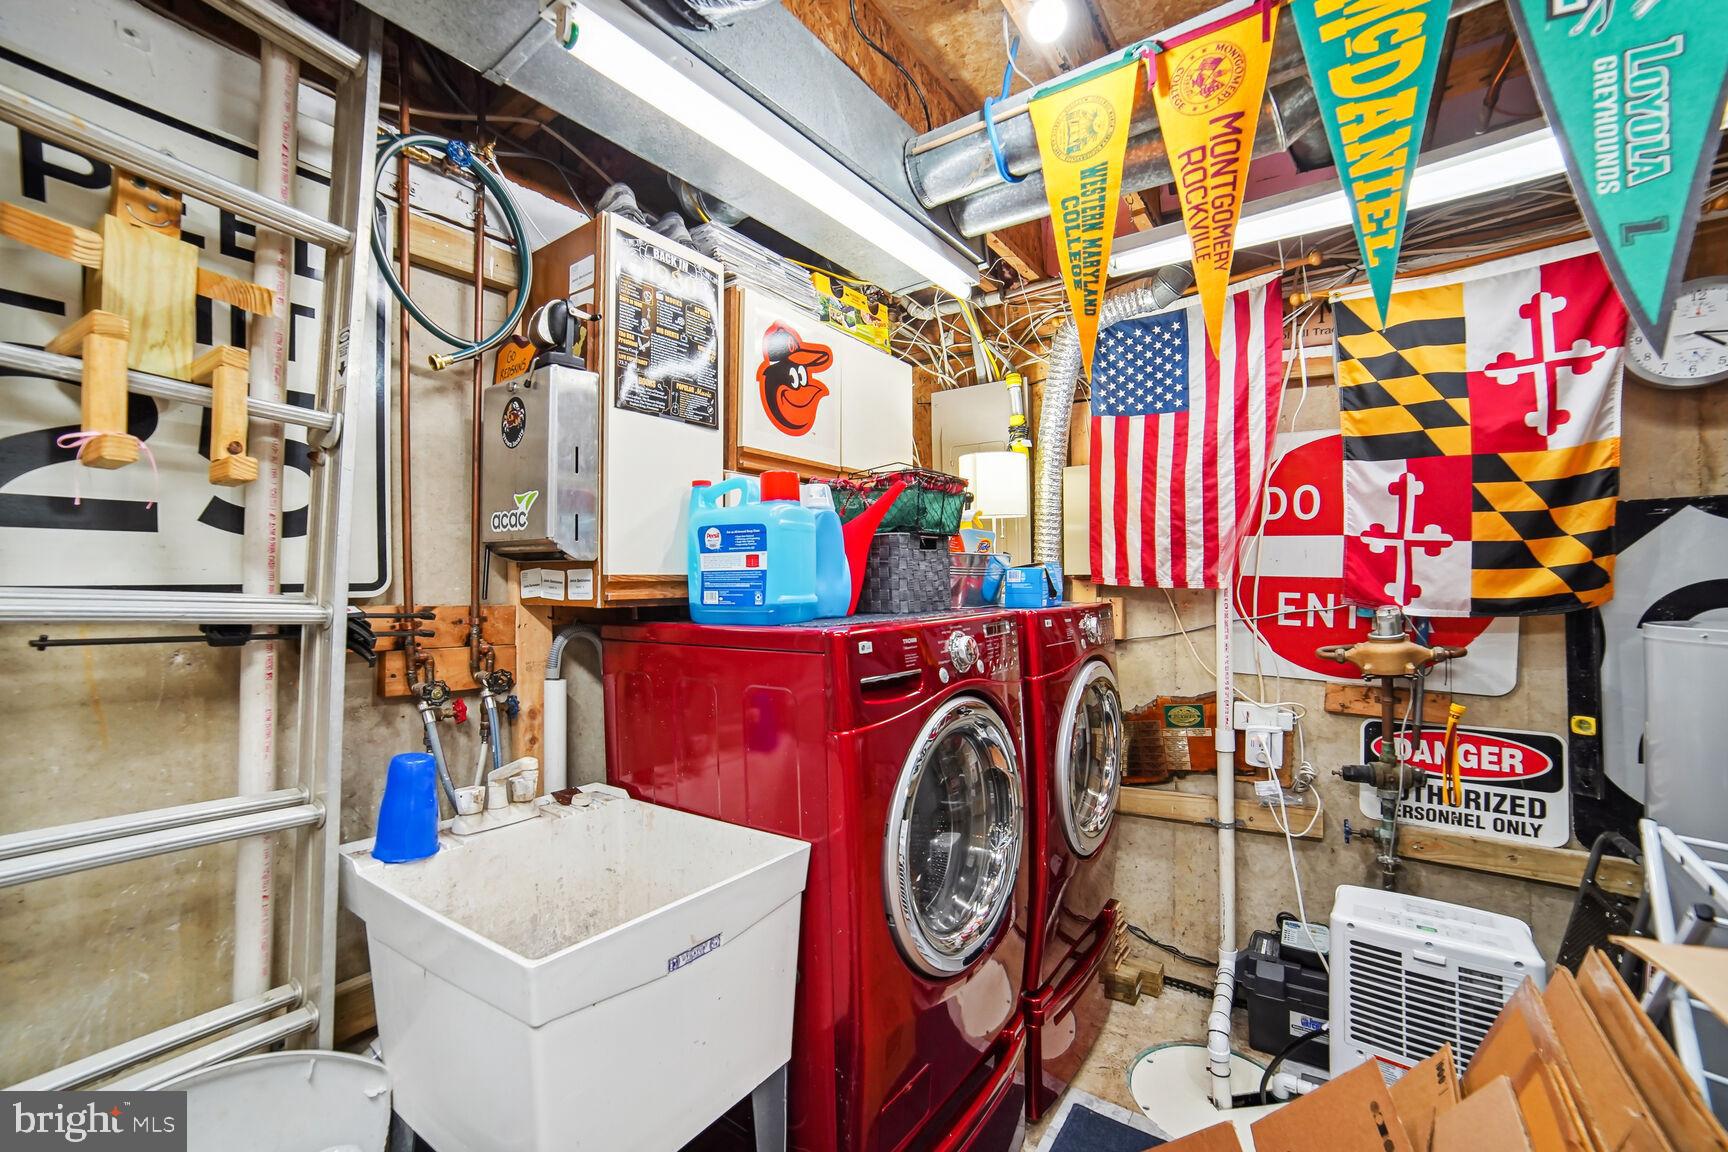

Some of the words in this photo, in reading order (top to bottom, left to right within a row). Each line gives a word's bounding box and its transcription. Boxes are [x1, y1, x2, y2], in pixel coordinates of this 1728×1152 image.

[1170, 67, 1186, 110] COLLEGE
[1216, 43, 1246, 104] MONTGOMERY
[1592, 54, 1621, 195] GREYHOUNDS
[1624, 33, 1685, 188] LOYOLA
[1080, 160, 1108, 233] WESTERN
[1178, 145, 1211, 263] ROCKVILLE
[1209, 111, 1245, 271] MONTGOMERY
[653, 247, 678, 269] BACK
[1061, 195, 1082, 291] COLLEGE
[1081, 237, 1103, 316] MARYLAND
[1691, 290, 1707, 301] 12
[507, 350, 516, 363] GO
[492, 510, 527, 530] acac
[1268, 484, 1321, 521] DO
[977, 541, 991, 552] Tide
[1393, 738, 1524, 774] DANGER
[1381, 800, 1485, 830] ERSONNEL
[1493, 817, 1543, 838] ONLY
